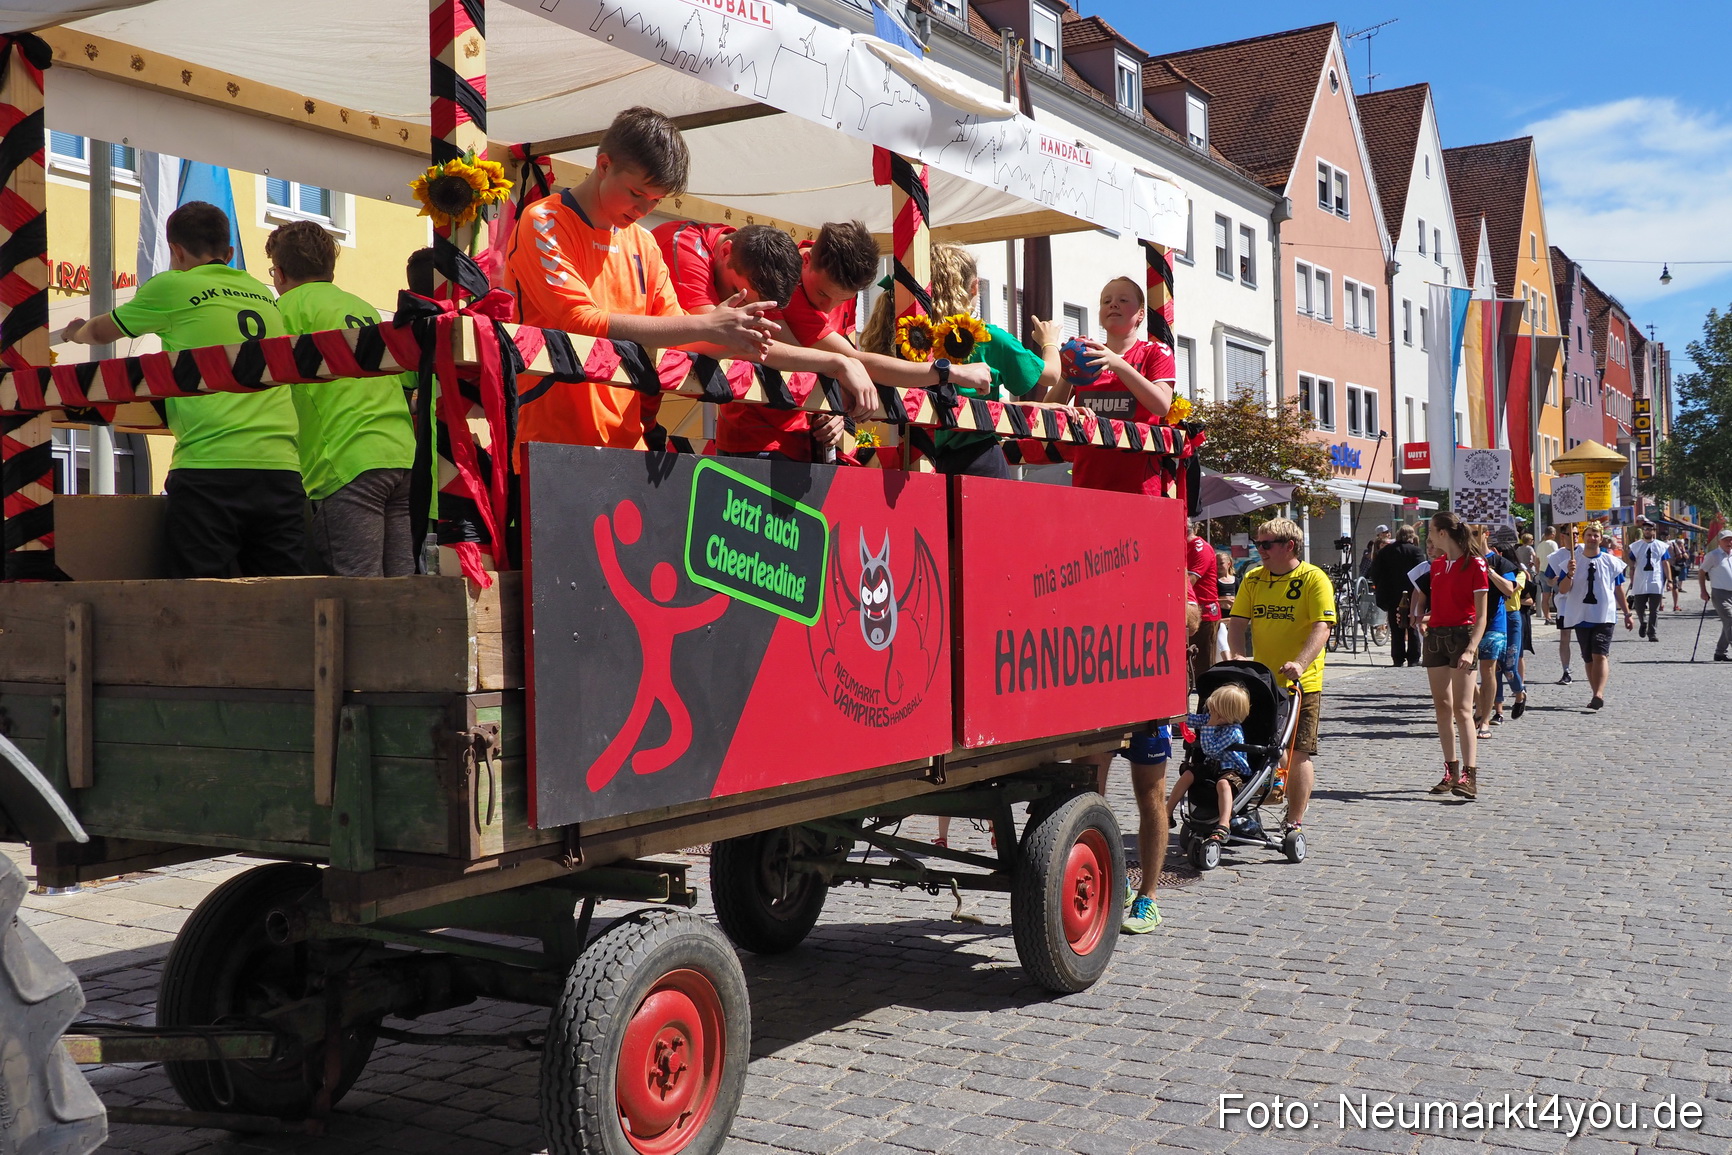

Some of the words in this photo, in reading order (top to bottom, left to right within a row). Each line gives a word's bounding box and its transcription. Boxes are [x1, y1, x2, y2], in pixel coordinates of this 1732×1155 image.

[1041, 137, 1091, 165] HANDBALL
[633, 254, 646, 294] 1
[189, 288, 218, 307] DJK
[1083, 398, 1130, 412] THULE
[1465, 449, 1500, 463] SCHACHKLUB
[1635, 400, 1651, 479] HOTEL
[1464, 471, 1493, 486] NEUMARKT
[722, 489, 762, 534] Jetzt
[764, 513, 800, 551] auch
[706, 534, 807, 603] Cheerleading
[1033, 564, 1057, 598] mia
[1060, 560, 1081, 588] san
[1084, 537, 1139, 579] Neimakt's
[1267, 605, 1295, 614] Sport
[1286, 579, 1303, 600] 8
[995, 621, 1170, 695] HANDBALLER
[834, 661, 880, 704] NEUMARKT
[834, 684, 890, 727] VAMPIRES
[890, 692, 922, 725] HANDBALL
